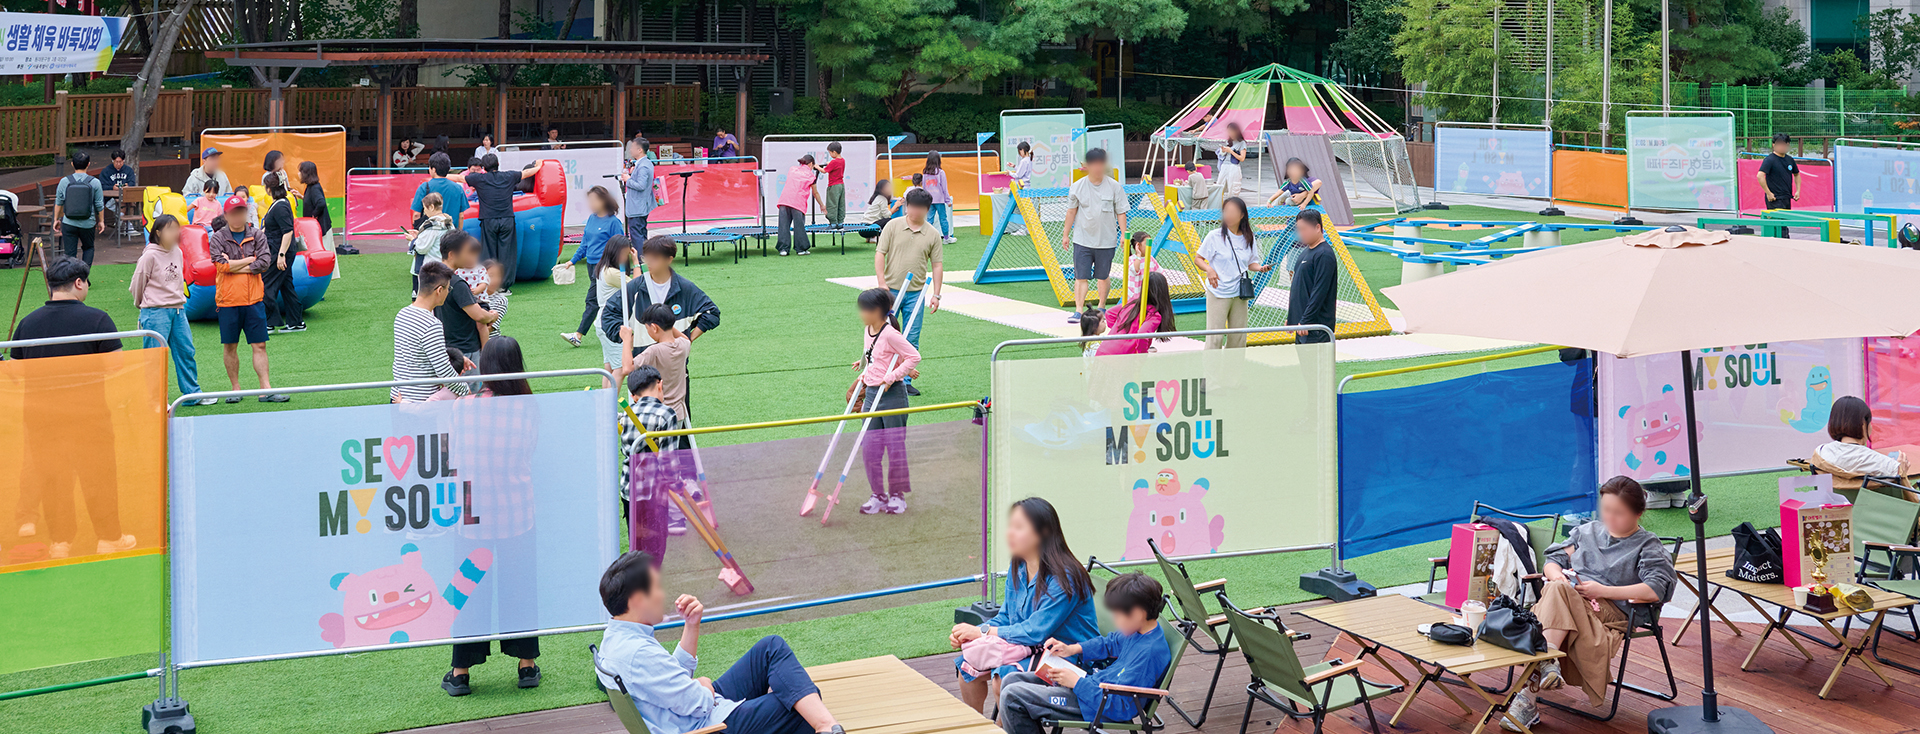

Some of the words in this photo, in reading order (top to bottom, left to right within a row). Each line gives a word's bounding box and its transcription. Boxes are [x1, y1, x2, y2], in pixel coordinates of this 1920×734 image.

[7, 24, 32, 51] 생활
[32, 24, 57, 51] 체육
[57, 26, 104, 51] 바둑대회
[1724, 352, 1781, 389] SOUL
[1156, 419, 1229, 461] SOUL
[385, 480, 480, 531] SOUL
[1738, 568, 1779, 583] Matters.
[1743, 560, 1772, 576] Impact
